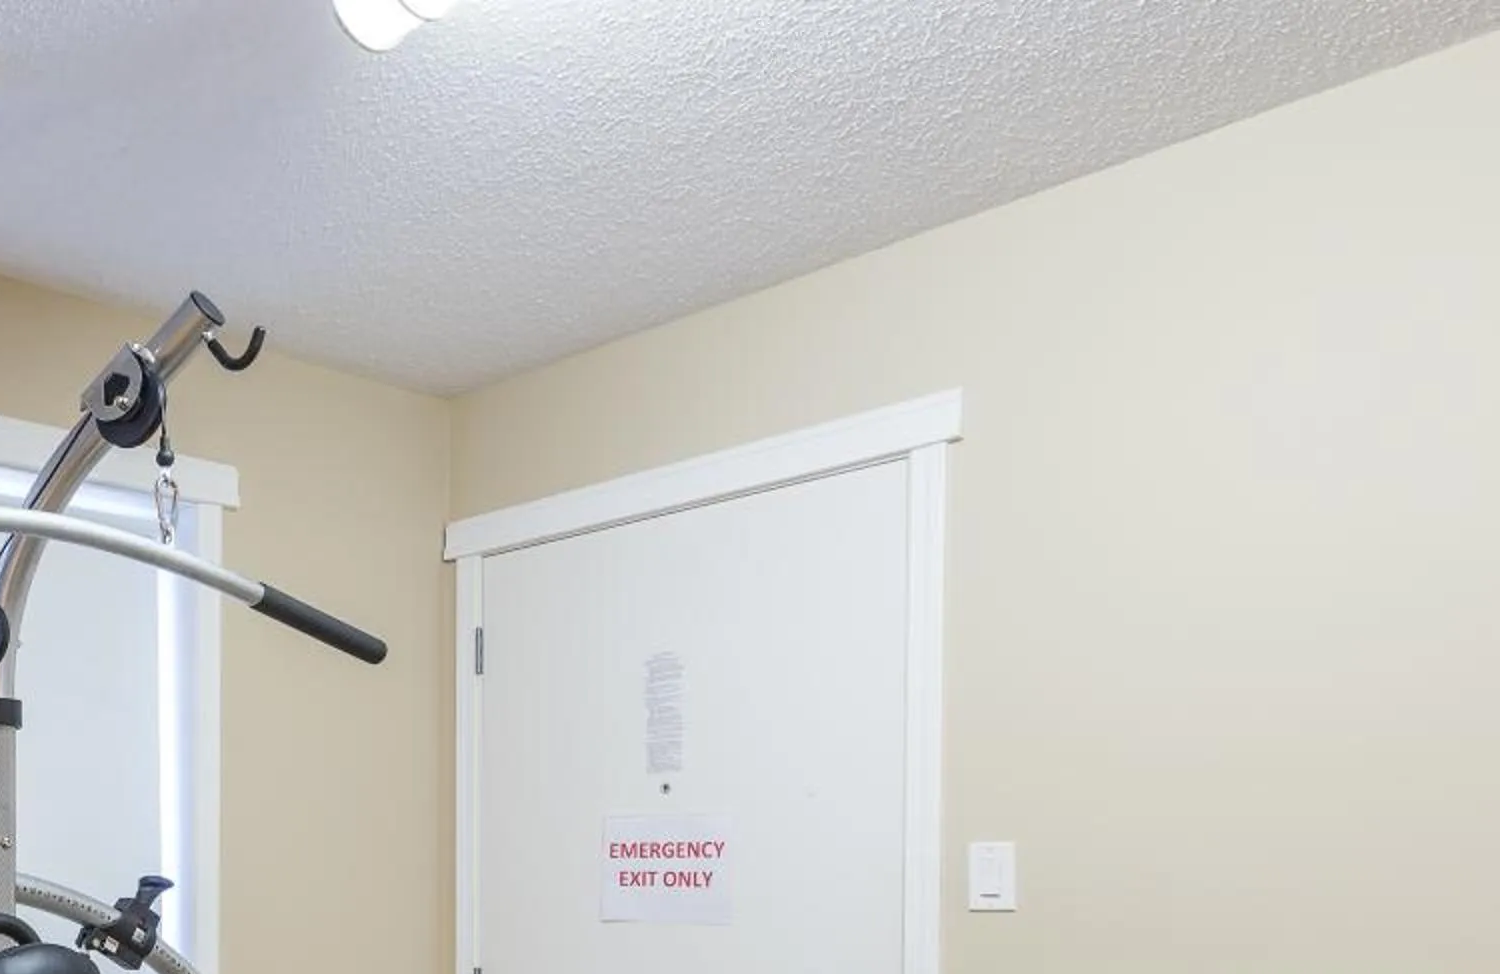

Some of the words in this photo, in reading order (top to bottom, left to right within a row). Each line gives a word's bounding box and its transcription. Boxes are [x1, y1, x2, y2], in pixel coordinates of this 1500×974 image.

[610, 841, 725, 859] EMERGENCY
[619, 871, 658, 887] EXIT
[663, 871, 713, 887] ONLY
